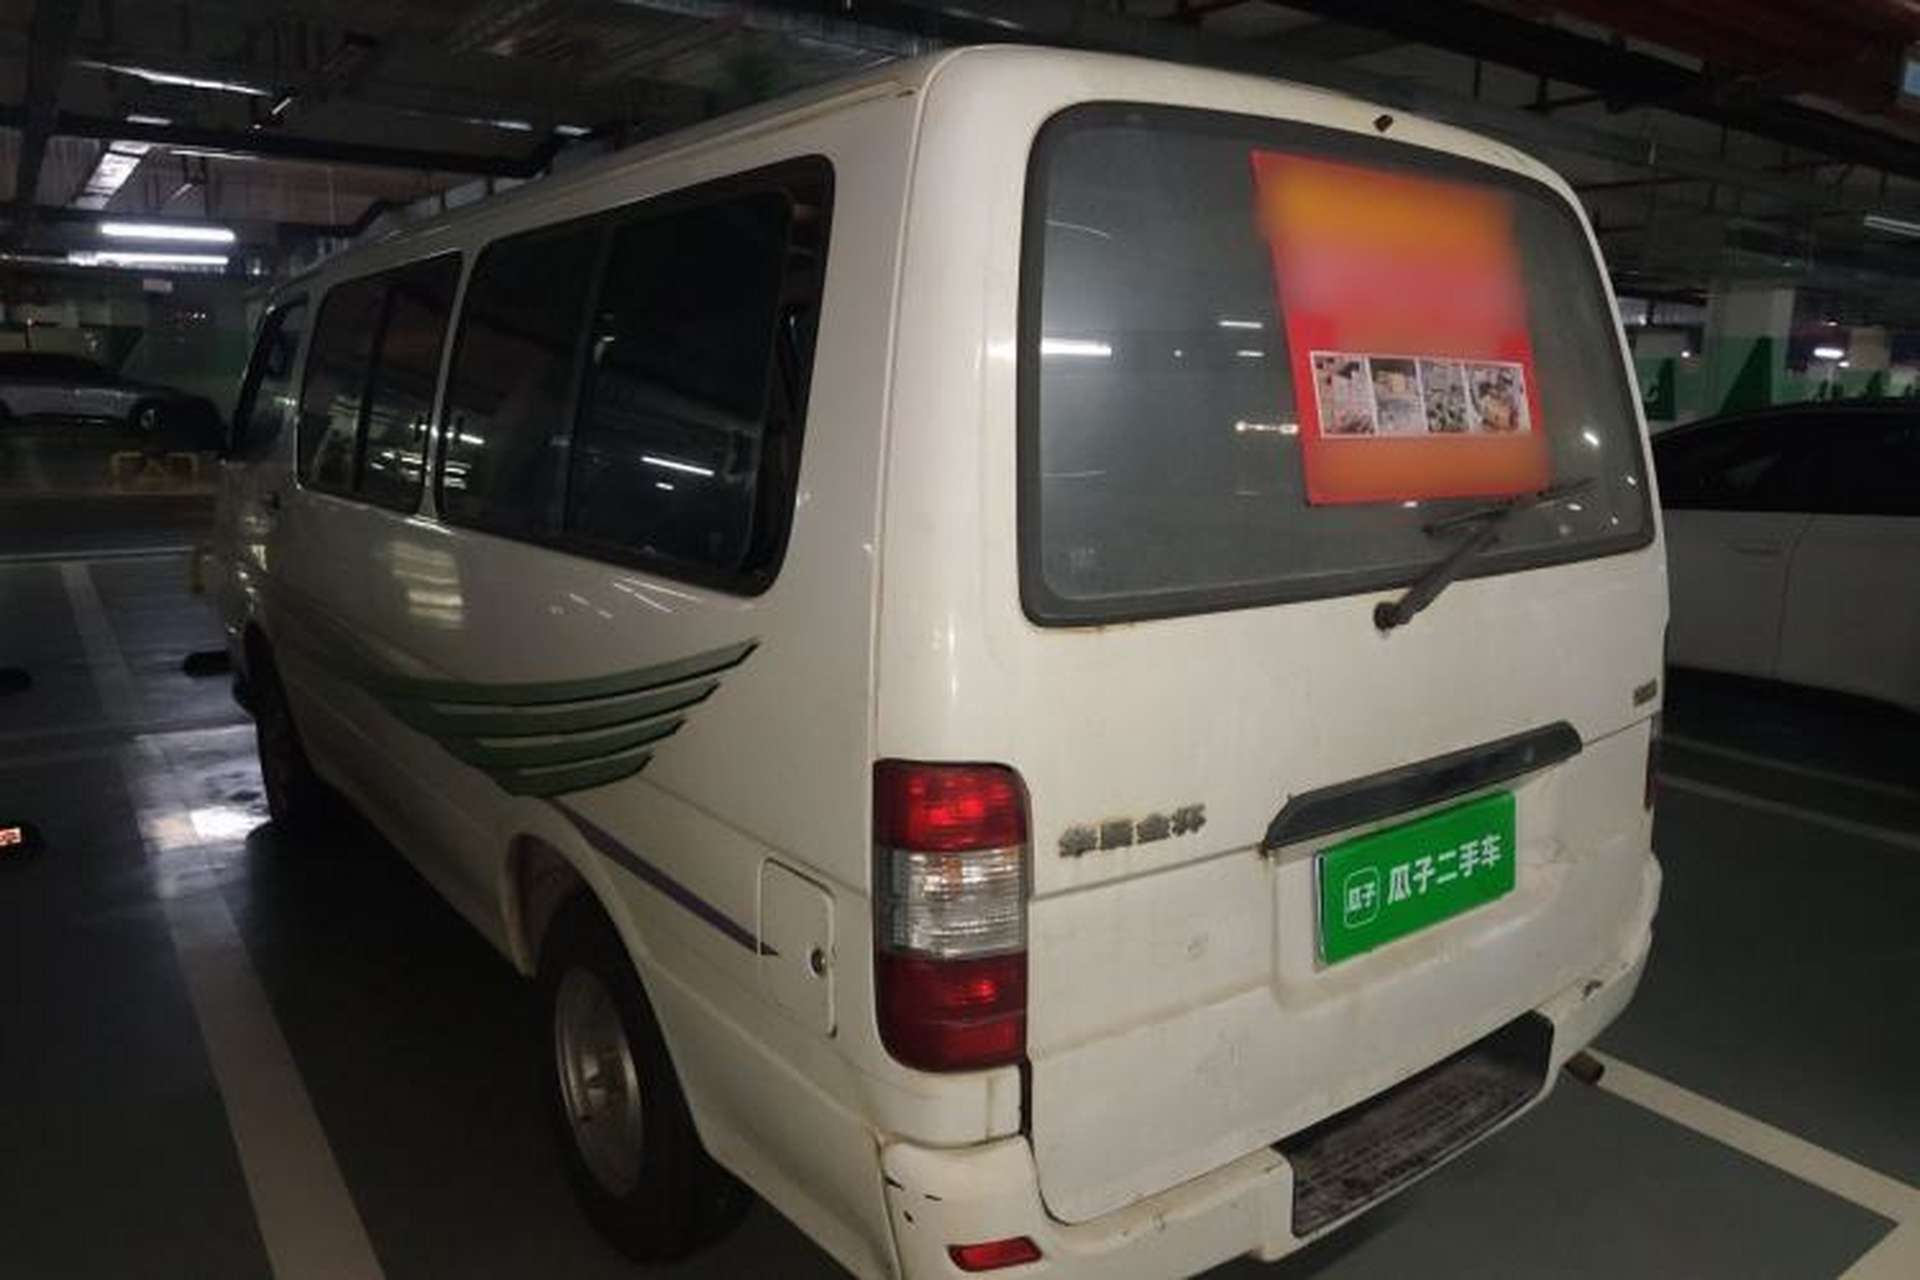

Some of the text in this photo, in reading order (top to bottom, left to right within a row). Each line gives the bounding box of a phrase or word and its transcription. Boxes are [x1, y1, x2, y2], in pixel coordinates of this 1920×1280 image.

[1387, 834, 1502, 904] 瓜子二手车
